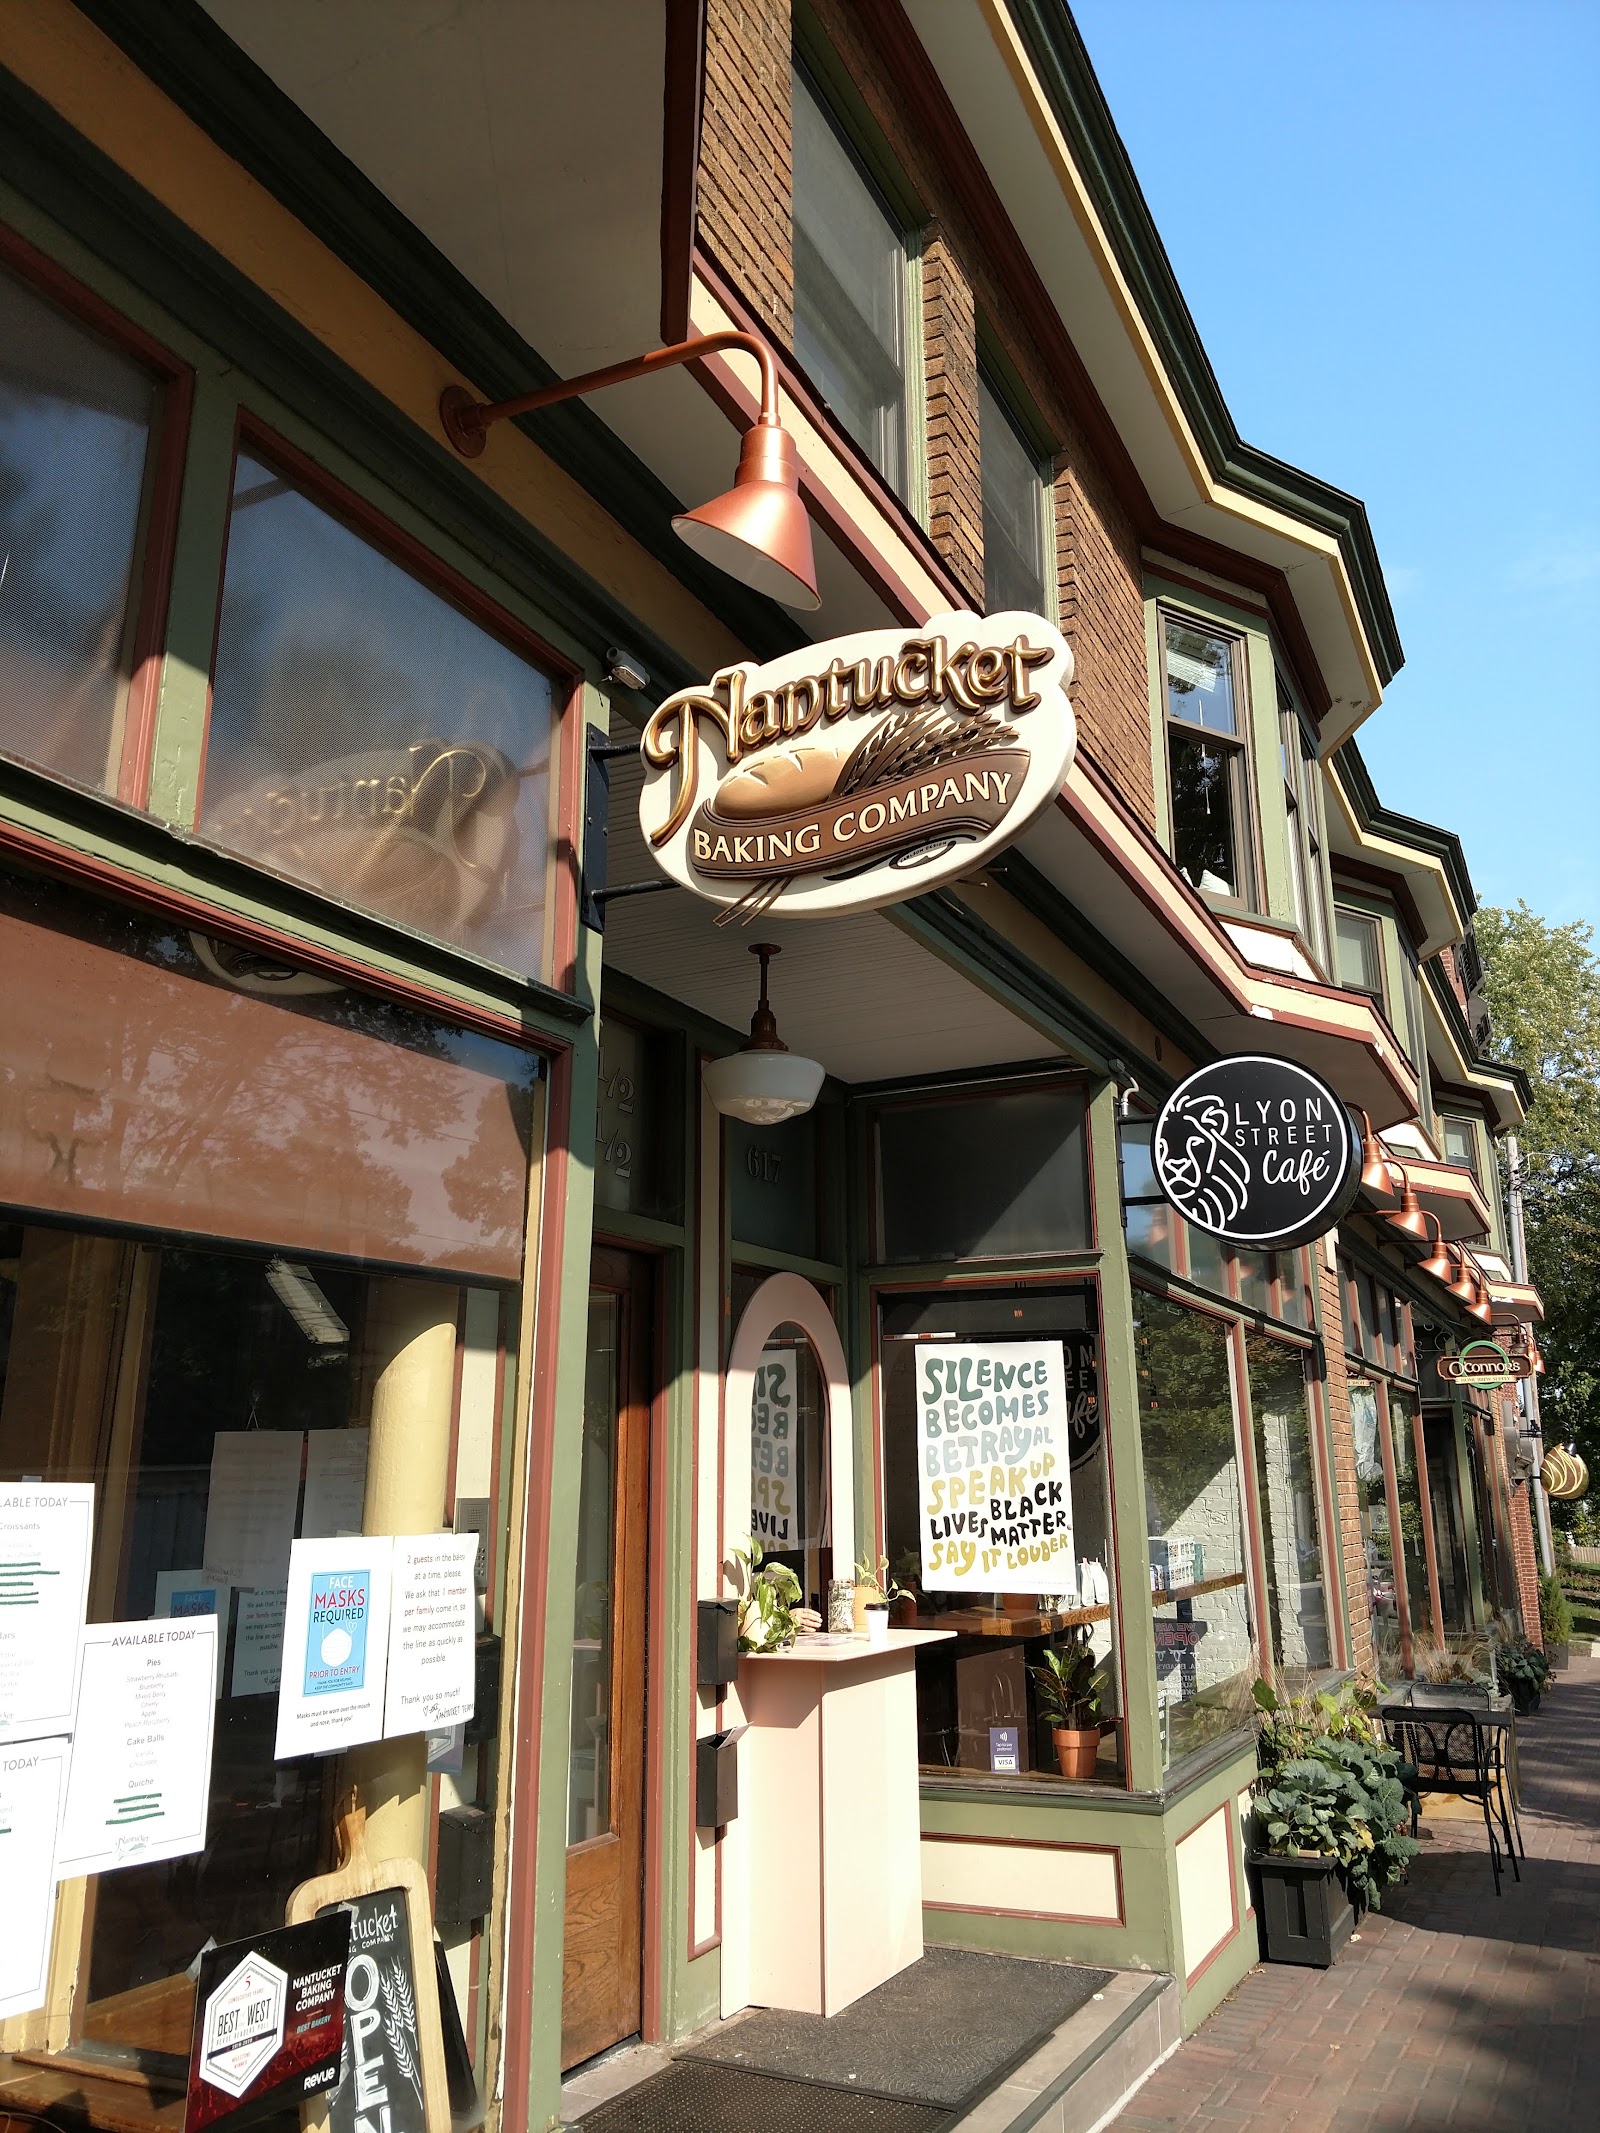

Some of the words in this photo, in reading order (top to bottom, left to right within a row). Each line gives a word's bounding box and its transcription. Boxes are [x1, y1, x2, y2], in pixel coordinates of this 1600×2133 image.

[645, 634, 1054, 847] Nantucket
[692, 822, 821, 863] BAKING
[832, 770, 1014, 842] COMPANY
[1235, 1097, 1322, 1125] LYON
[1235, 1124, 1332, 1147] STREET
[748, 1146, 782, 1184] 617
[1263, 1149, 1331, 1196] Café
[922, 1357, 1048, 1405] SILENCE
[926, 1390, 1049, 1438] BECOMES
[926, 1425, 1054, 1477] BETRAYAL
[927, 1466, 1027, 1515] SPEAK
[1030, 1452, 1055, 1478] UP
[35, 1497, 68, 1507] TODAY
[990, 1481, 1062, 1520] BLACK
[930, 1511, 988, 1539] LIVES
[991, 1510, 1066, 1547] MATTER
[407, 1555, 411, 1564] 2
[413, 1555, 433, 1565] guests
[435, 1554, 440, 1562] in
[442, 1553, 451, 1561] the
[929, 1540, 976, 1576] SAY
[982, 1549, 1001, 1573] IT
[1007, 1534, 1068, 1569] LOUDER
[329, 1576, 353, 1589] FACE
[314, 1589, 364, 1609] MASKS
[405, 1590, 414, 1599] We
[416, 1589, 426, 1598] ask
[428, 1588, 440, 1597] that
[173, 1602, 211, 1616] MASKS
[313, 1608, 364, 1624] REQUIRED
[404, 1609, 414, 1617] per
[416, 1605, 434, 1615] family
[436, 1605, 451, 1613] come
[112, 1633, 164, 1646] AVAILABLE
[167, 1630, 196, 1641] TODAY
[413, 1624, 426, 1633] may
[403, 1641, 413, 1650] the
[415, 1640, 426, 1648] line
[437, 1636, 456, 1645] quickly
[309, 1670, 328, 1679] PRIOR
[340, 1665, 360, 1675] ENTRY
[401, 1694, 420, 1704] Thank
[422, 1693, 434, 1703] you
[436, 1692, 442, 1700] so
[127, 1738, 145, 1746] Cake
[147, 1734, 164, 1743] Balls
[3, 1756, 39, 1771] TODAY
[128, 1778, 154, 1789] Quiche
[349, 1904, 398, 1943] tucket
[245, 1975, 251, 1991] 5
[293, 1964, 342, 1990] NANTUCKET
[301, 1979, 332, 1998] BAKING
[295, 1989, 335, 2012] COMPANY
[218, 2009, 240, 2037] BEST
[247, 1998, 271, 2026] WEST
[296, 2022, 310, 2034] BEST
[311, 2014, 331, 2029] BAKERY
